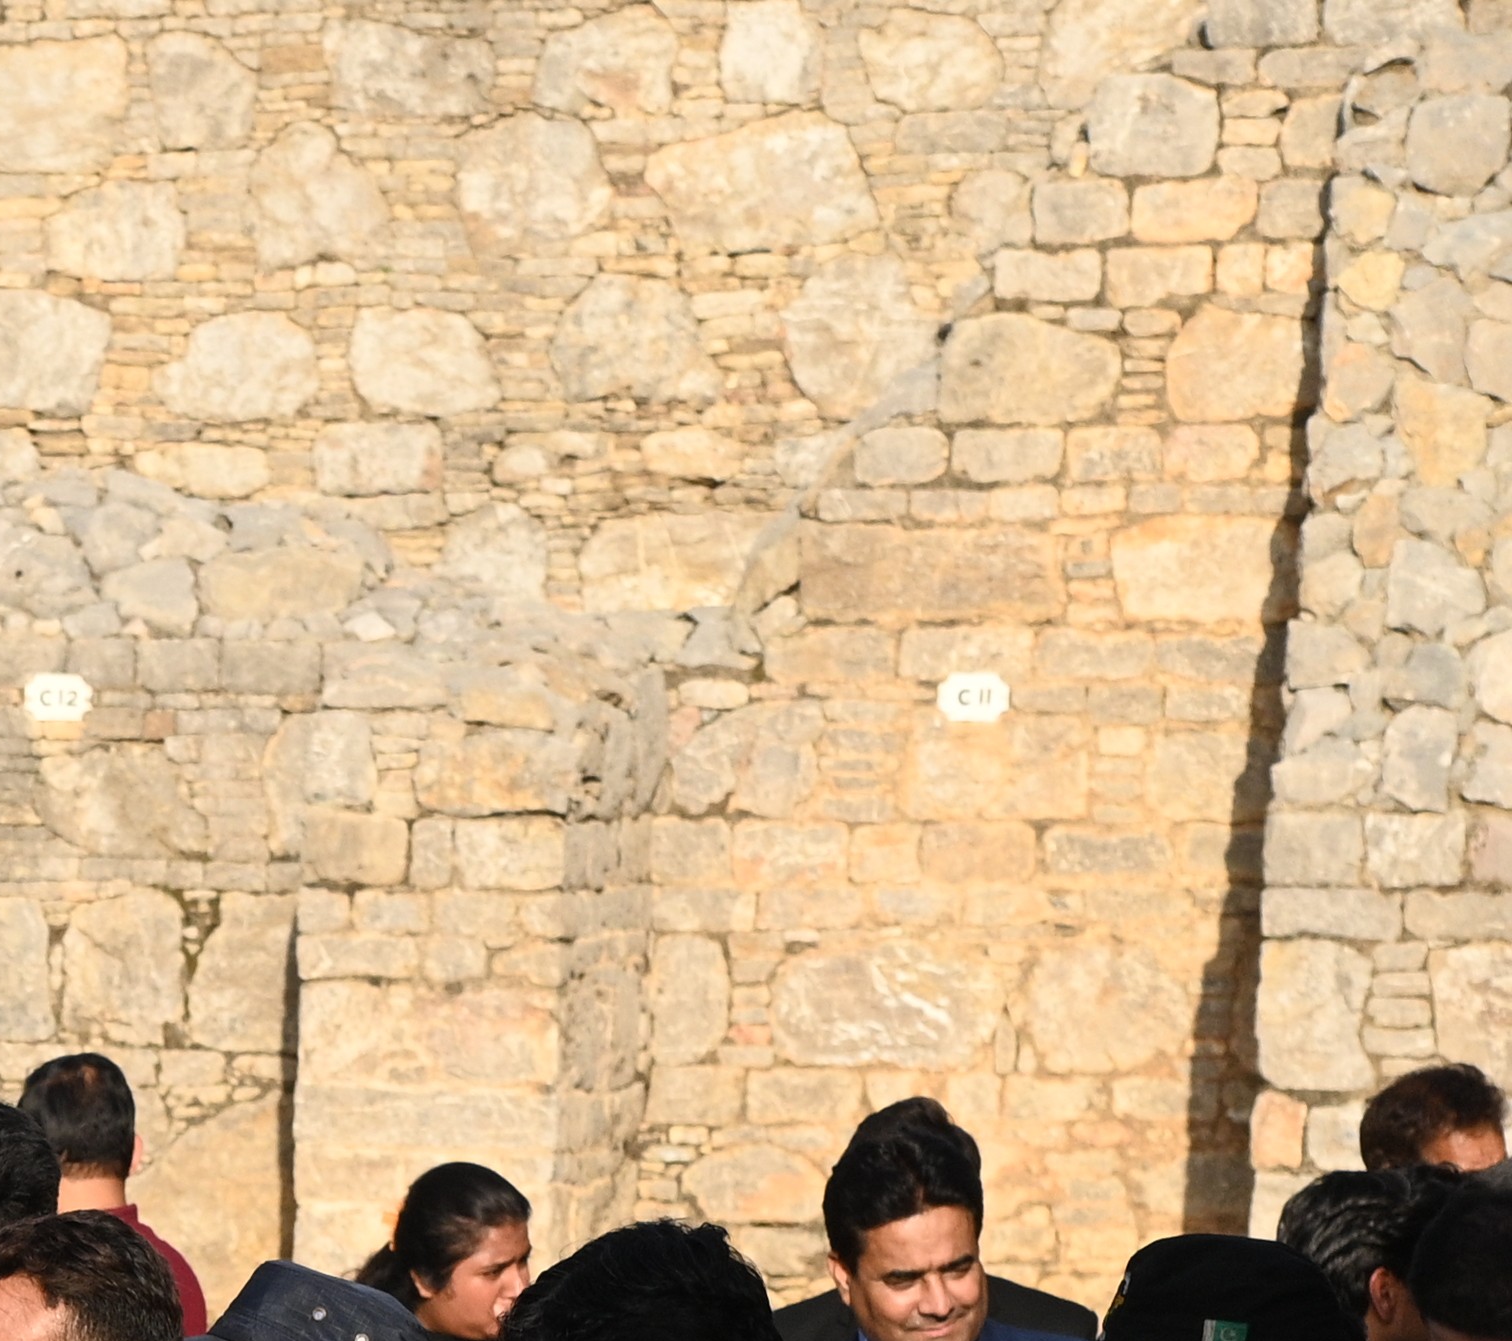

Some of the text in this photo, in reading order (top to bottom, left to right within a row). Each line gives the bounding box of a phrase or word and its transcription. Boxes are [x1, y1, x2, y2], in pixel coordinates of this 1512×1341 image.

[39, 689, 78, 707] C 12
[958, 689, 971, 706] C
